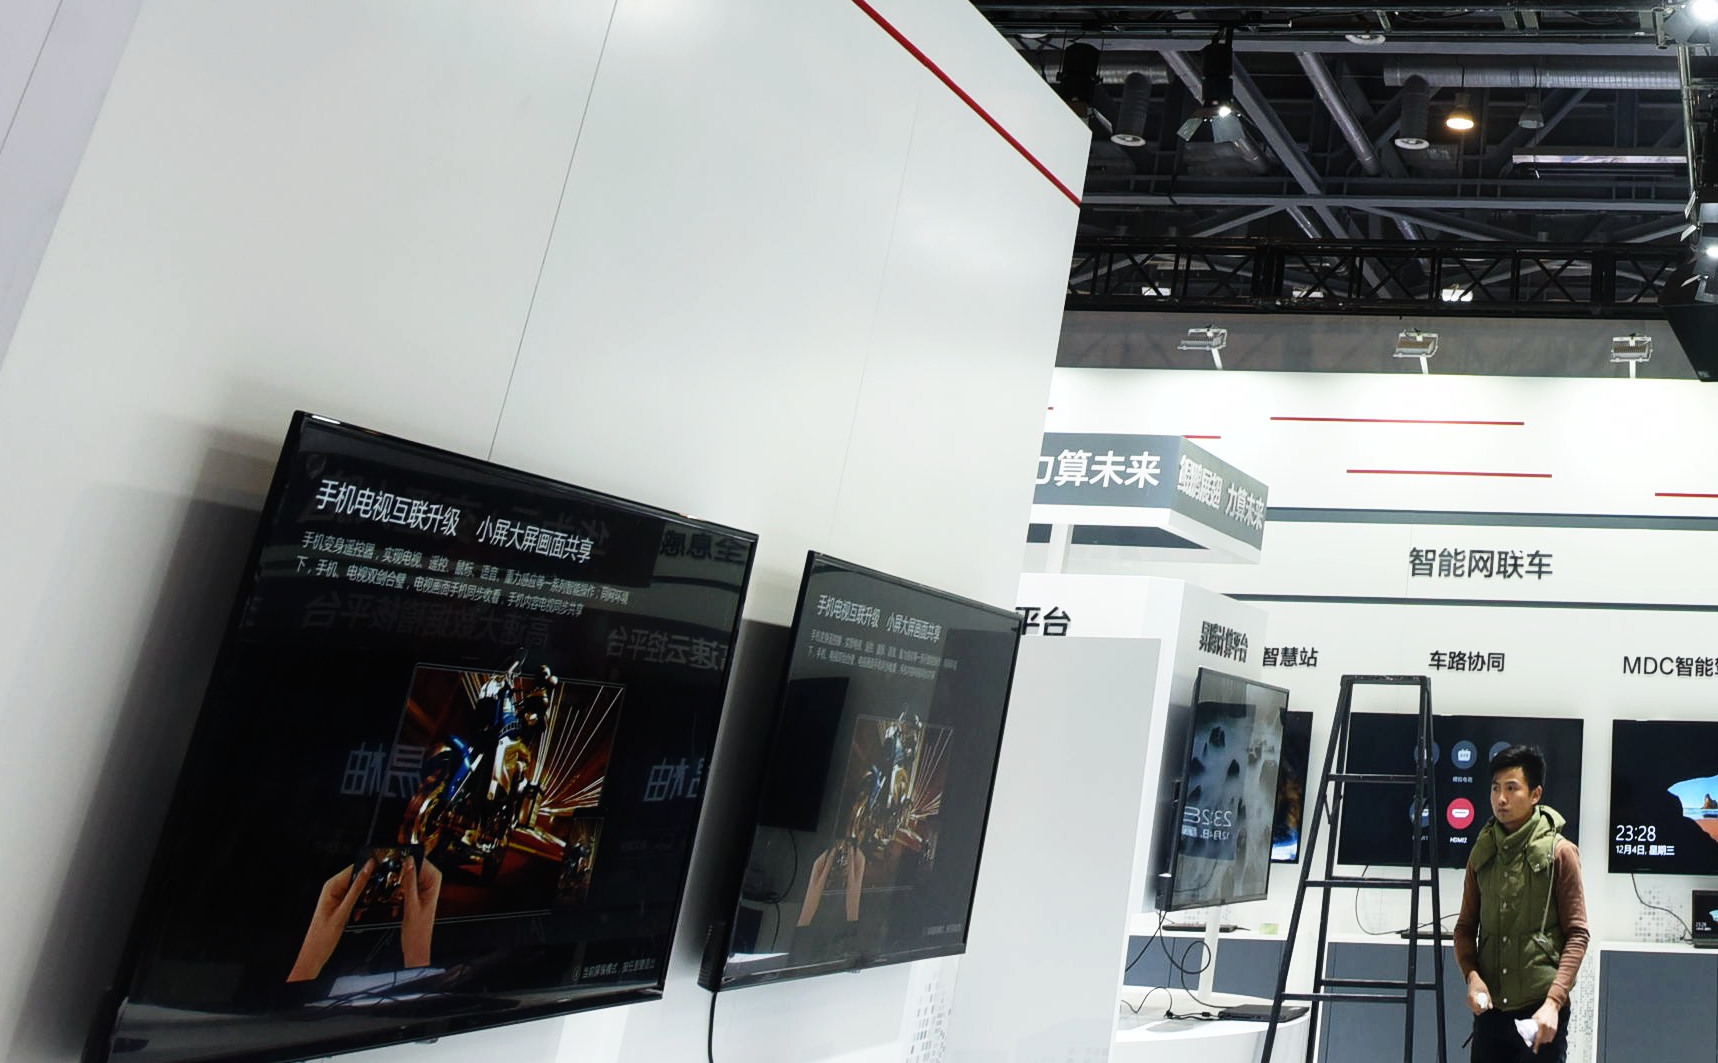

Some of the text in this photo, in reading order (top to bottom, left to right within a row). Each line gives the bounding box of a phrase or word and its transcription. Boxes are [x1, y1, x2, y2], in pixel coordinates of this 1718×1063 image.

[1225, 482, 1265, 530] 力算未来
[315, 479, 594, 564] 手机电视互联升级 小屏大屏画面共享
[1409, 547, 1553, 580] 智能网联车
[1262, 646, 1319, 667] 智慧站
[1428, 649, 1505, 672] 车路协同
[1615, 824, 1657, 843] 23:28
